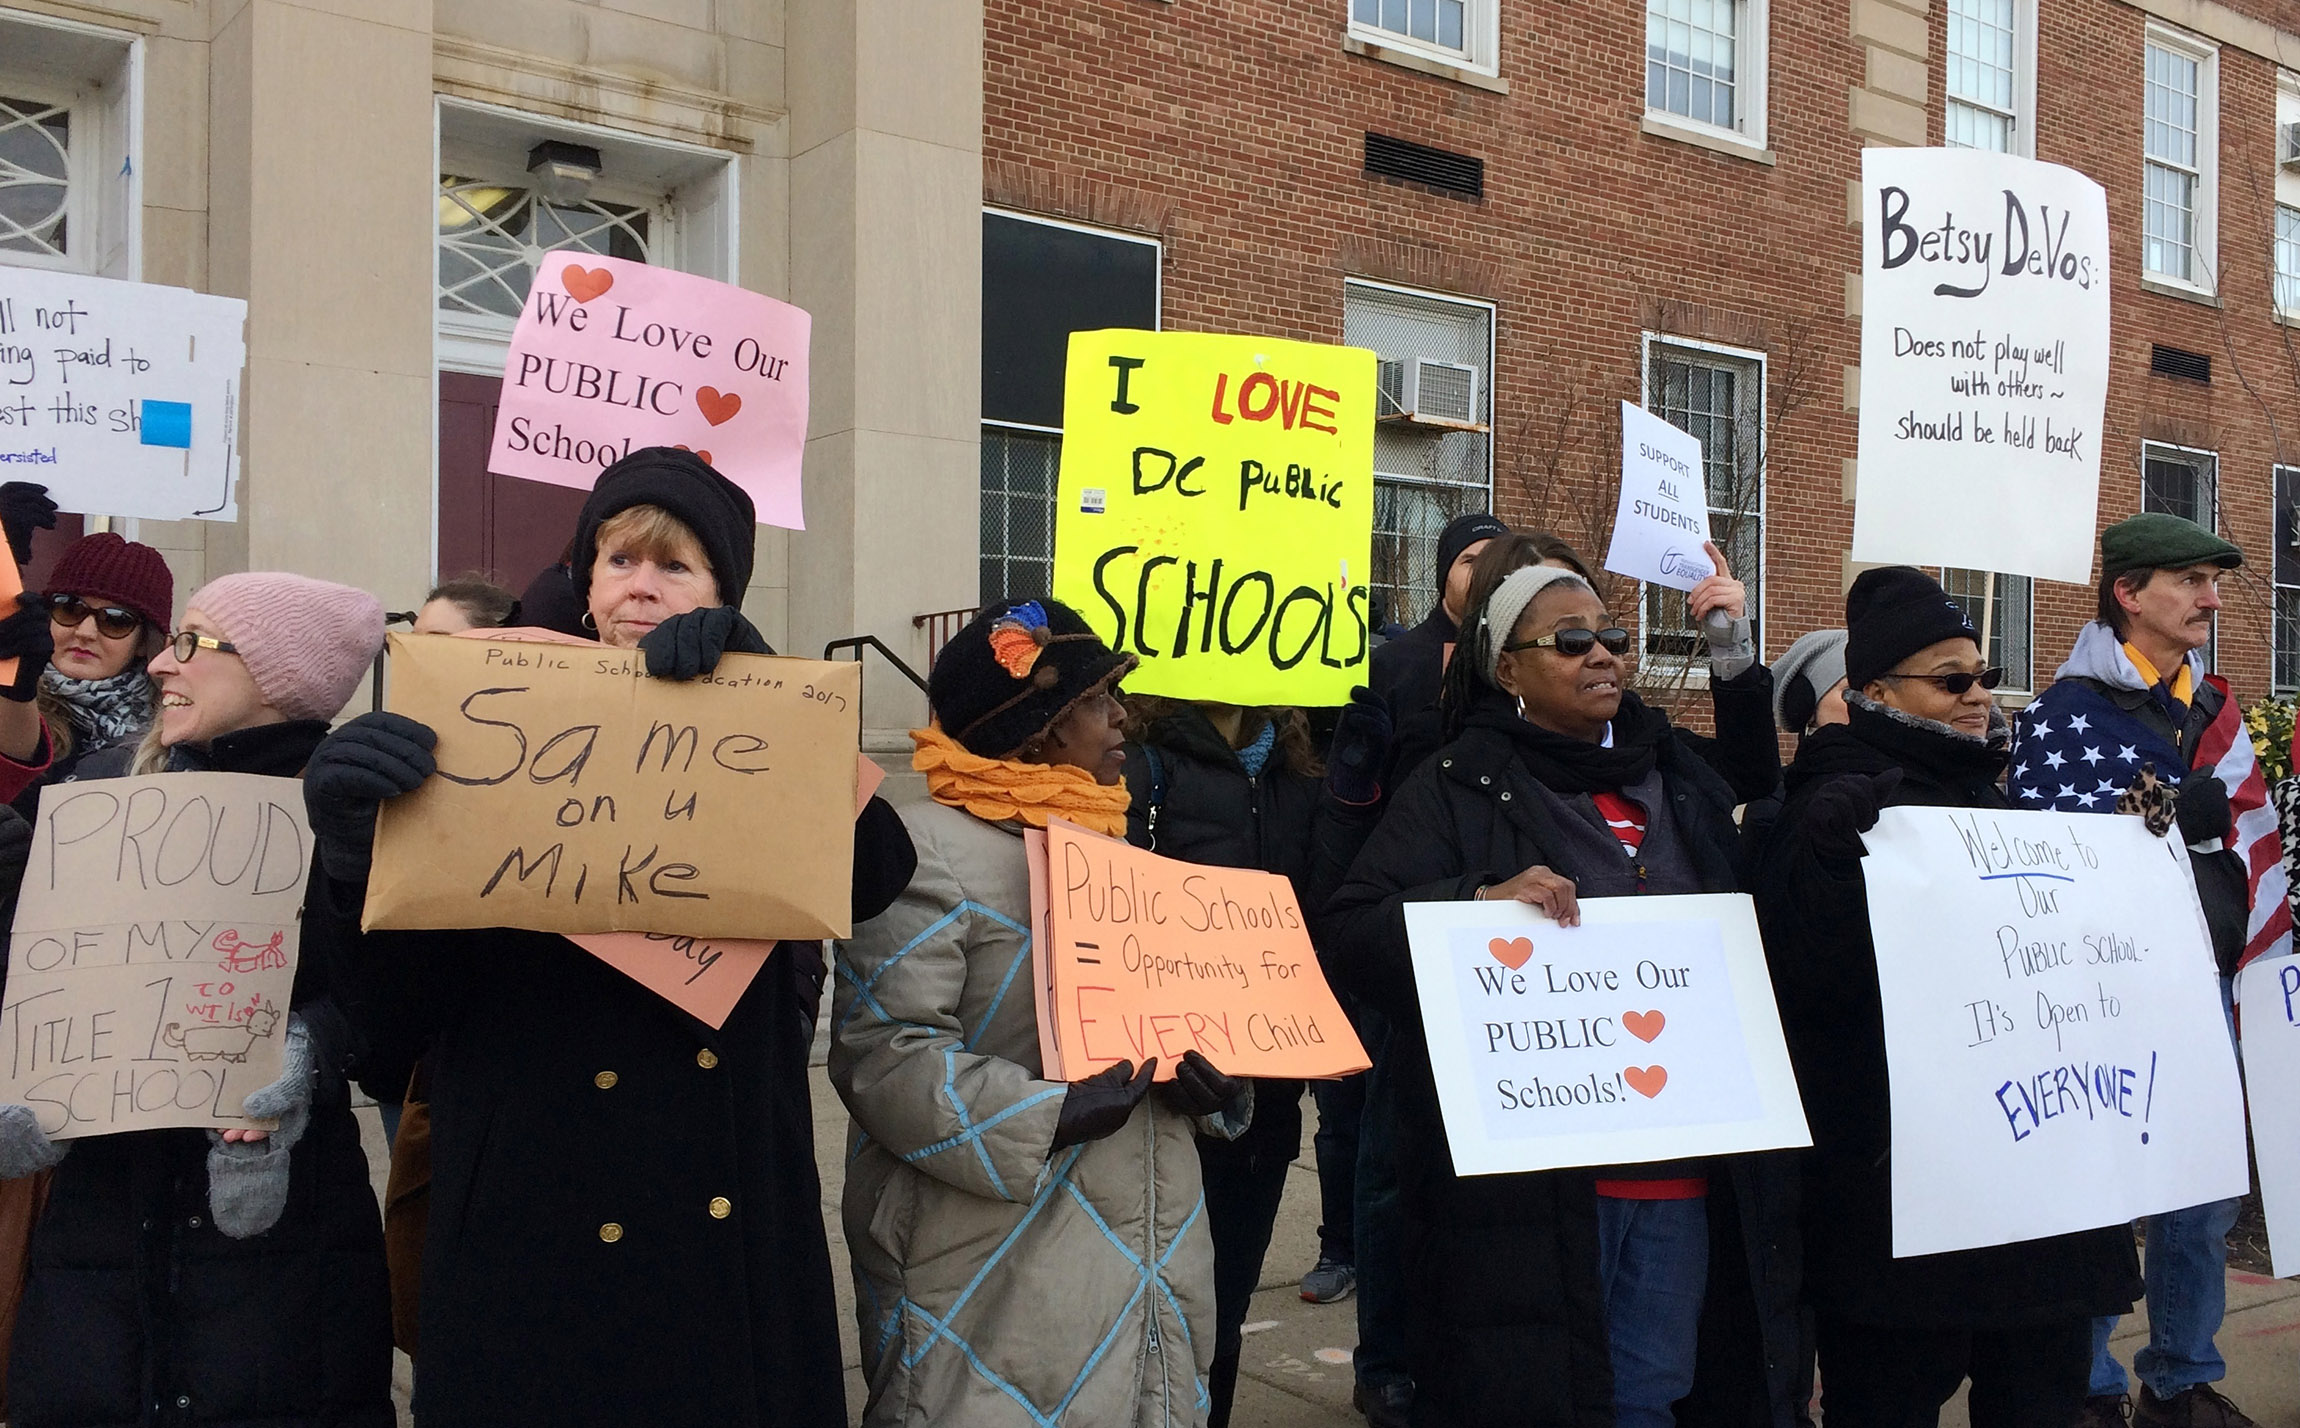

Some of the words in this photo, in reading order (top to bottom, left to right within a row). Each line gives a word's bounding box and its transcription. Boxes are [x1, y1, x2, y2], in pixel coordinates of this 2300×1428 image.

[1880, 186, 1992, 298] Betsy
[2001, 189, 2099, 290] DeVos:
[36, 299, 88, 335] not
[536, 291, 588, 332] We
[611, 305, 712, 358] Love
[734, 337, 789, 382] Our
[54, 337, 112, 384] paid
[121, 347, 151, 375] to
[1894, 326, 1946, 357] Does
[1952, 329, 1987, 360] not
[1995, 333, 2029, 384] play
[2034, 339, 2065, 374] well
[48, 390, 97, 425] this
[515, 353, 684, 416] PUBLIC
[1108, 355, 1146, 415] I
[1211, 371, 1341, 435] LOVE
[1951, 370, 1990, 397] with
[1998, 369, 2043, 399] others
[1640, 442, 1690, 478] SUPPORT
[1974, 410, 1995, 443] be
[2004, 411, 2035, 450] held
[2045, 416, 2083, 462] back
[1133, 446, 1206, 497] DC
[1657, 478, 1680, 500] ALL
[1633, 500, 1700, 535] STUDENTS
[1093, 546, 1368, 671] SCHOOLS
[486, 648, 570, 670] Public
[594, 660, 660, 682] Schoo
[802, 684, 847, 712] 2017
[556, 792, 617, 827] on
[664, 789, 698, 821] u
[48, 787, 303, 895] PROUD
[1948, 812, 2070, 874] Welcome
[2068, 825, 2099, 869] to
[1065, 841, 1167, 925] Public
[1181, 875, 1300, 932] Schools
[2014, 874, 2060, 918] Our
[26, 932, 104, 971] OF
[126, 920, 215, 963] MY
[1122, 934, 1249, 989] Opportunity
[1473, 965, 1527, 996] We
[1542, 962, 1619, 993] Love
[1636, 960, 1690, 989] Our
[4, 988, 117, 1080] TITLE
[131, 976, 178, 1062] 1
[1077, 986, 1236, 1060] EVERY
[1247, 1013, 1325, 1052] Child
[1484, 1017, 1617, 1053] PUBLIC
[1964, 999, 2015, 1048] It's
[2036, 990, 2089, 1052] Open
[2097, 982, 2121, 1018] to
[24, 1068, 244, 1135] SCHOOL
[1496, 1071, 1627, 1110] Schools!
[1995, 1050, 2157, 1145] EVERYONE!
